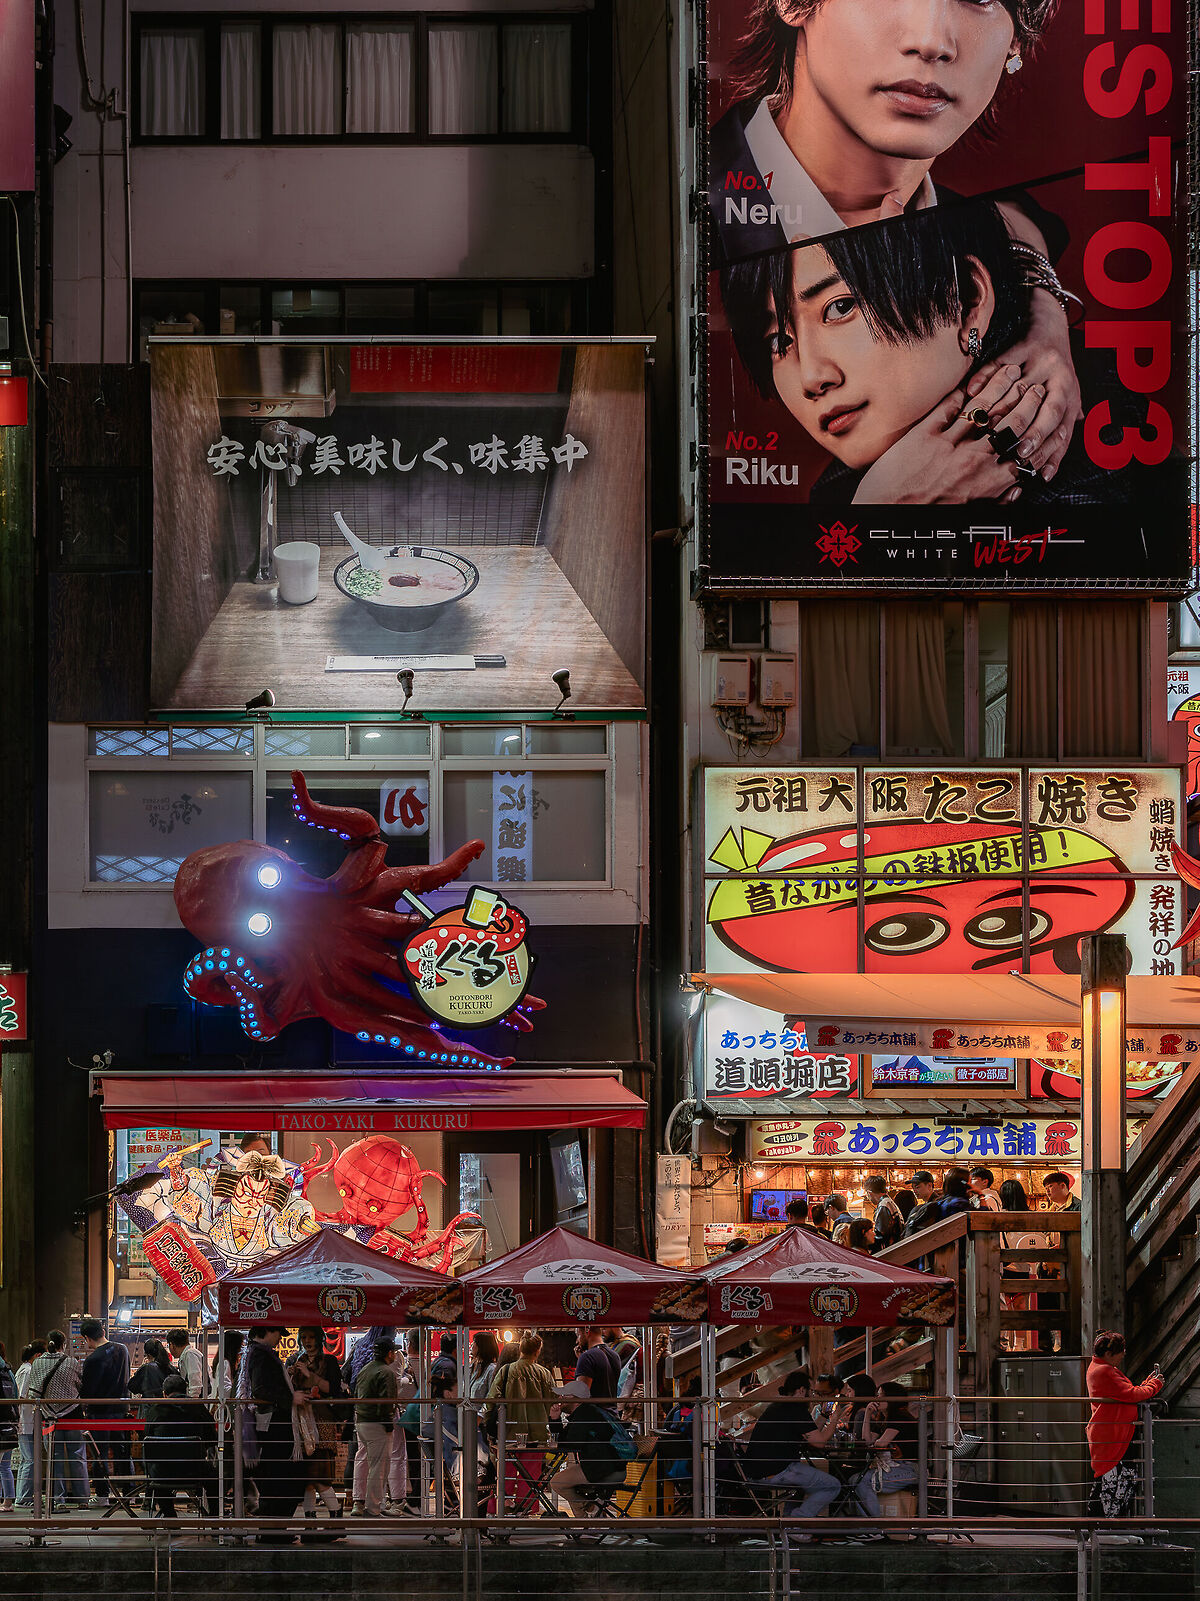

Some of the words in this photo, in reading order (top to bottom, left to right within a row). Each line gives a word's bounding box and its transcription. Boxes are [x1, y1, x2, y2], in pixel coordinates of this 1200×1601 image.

[725, 170, 775, 190] No.1
[725, 197, 804, 225] Neru
[1084, 136, 1173, 470] TOP3
[249, 400, 294, 415] コップ
[725, 430, 780, 451] No.2
[206, 434, 590, 477] 安心、美味しく、味集中
[725, 457, 800, 486] Riku
[869, 529, 957, 540] CLUB
[886, 547, 959, 559] WHITE
[735, 775, 1140, 825] 元祖大阪たこ焼き
[448, 1001, 494, 1010] KUKURU
[841, 1031, 917, 1048] あっちち本舗
[956, 1034, 1032, 1049] あっちち本舗
[714, 1058, 852, 1092] 道頓堀店
[956, 1068, 1009, 1081] 徹子の部屋
[277, 1113, 376, 1130] TAKO-YAKI
[394, 1113, 470, 1130] KUKURU
[847, 1120, 1038, 1157] あっちち本舗
[325, 1295, 359, 1311] No.1
[569, 1295, 604, 1311] No.1
[817, 1296, 851, 1312] No.1
[239, 1311, 268, 1320] KUKURU
[332, 1311, 352, 1323] 受賞
[484, 1311, 513, 1320] KUKURU
[576, 1310, 597, 1322] 受賞
[731, 1310, 760, 1319] KUKURU
[822, 1311, 843, 1324] 受賞
